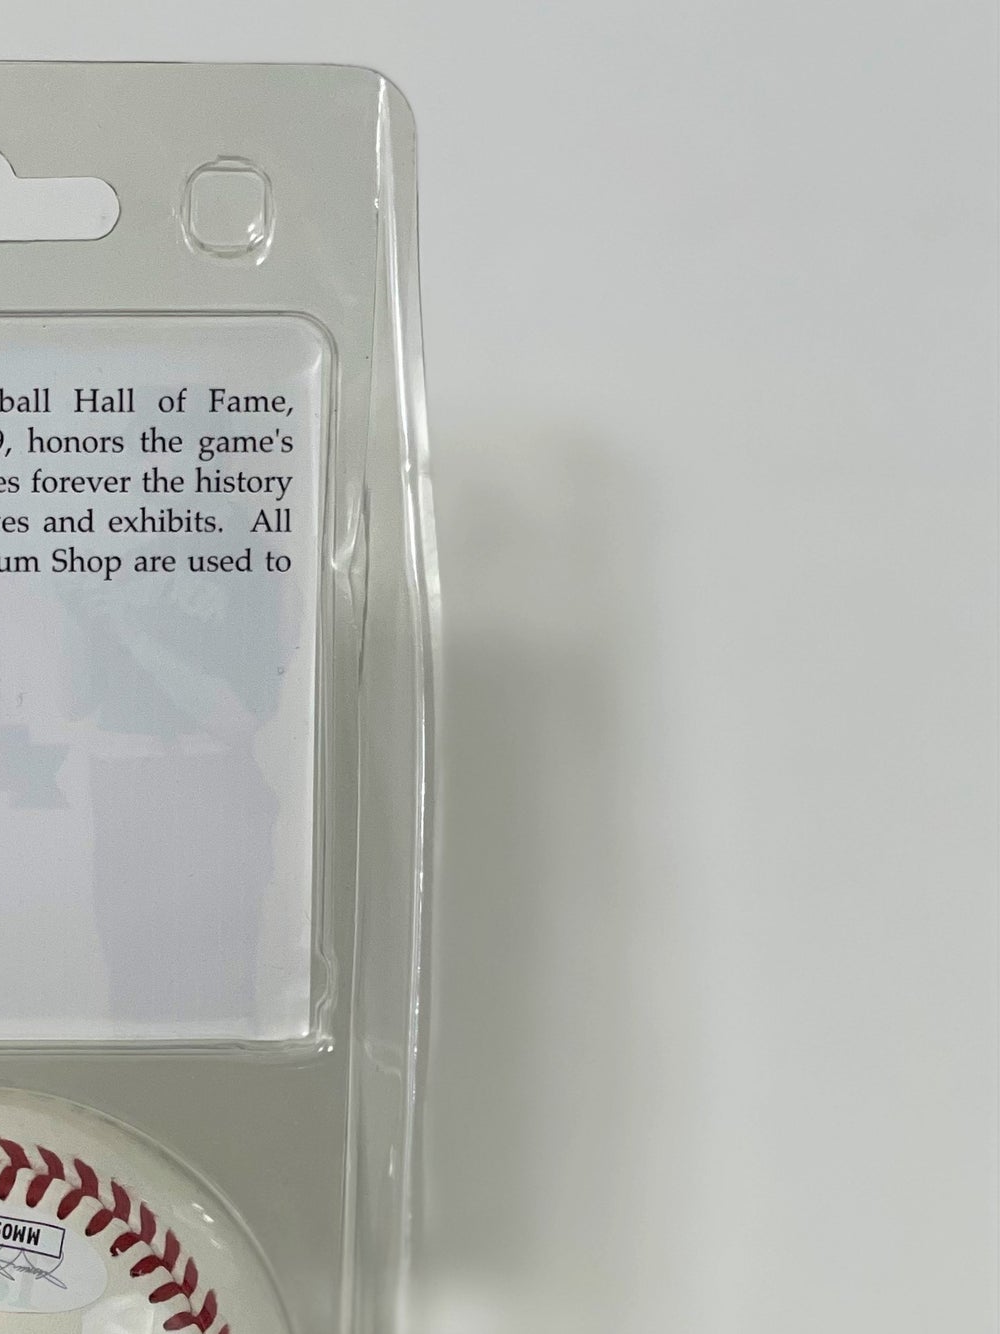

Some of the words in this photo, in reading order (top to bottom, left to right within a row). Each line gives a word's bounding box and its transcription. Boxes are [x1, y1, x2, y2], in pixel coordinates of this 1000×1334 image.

[74, 387, 135, 413] Hall
[158, 387, 188, 413] of
[208, 388, 294, 417] Fame,
[27, 426, 125, 454] honors
[140, 426, 183, 453] the
[198, 428, 294, 460] game's
[31, 468, 132, 494] forever
[141, 466, 185, 494] the
[194, 466, 293, 501] history
[43, 507, 95, 534] and
[108, 506, 223, 534] exhibits.
[249, 507, 292, 534] All
[51, 545, 122, 581] Shop
[134, 555, 177, 574] are
[187, 547, 253, 574] used
[265, 551, 292, 574] to
